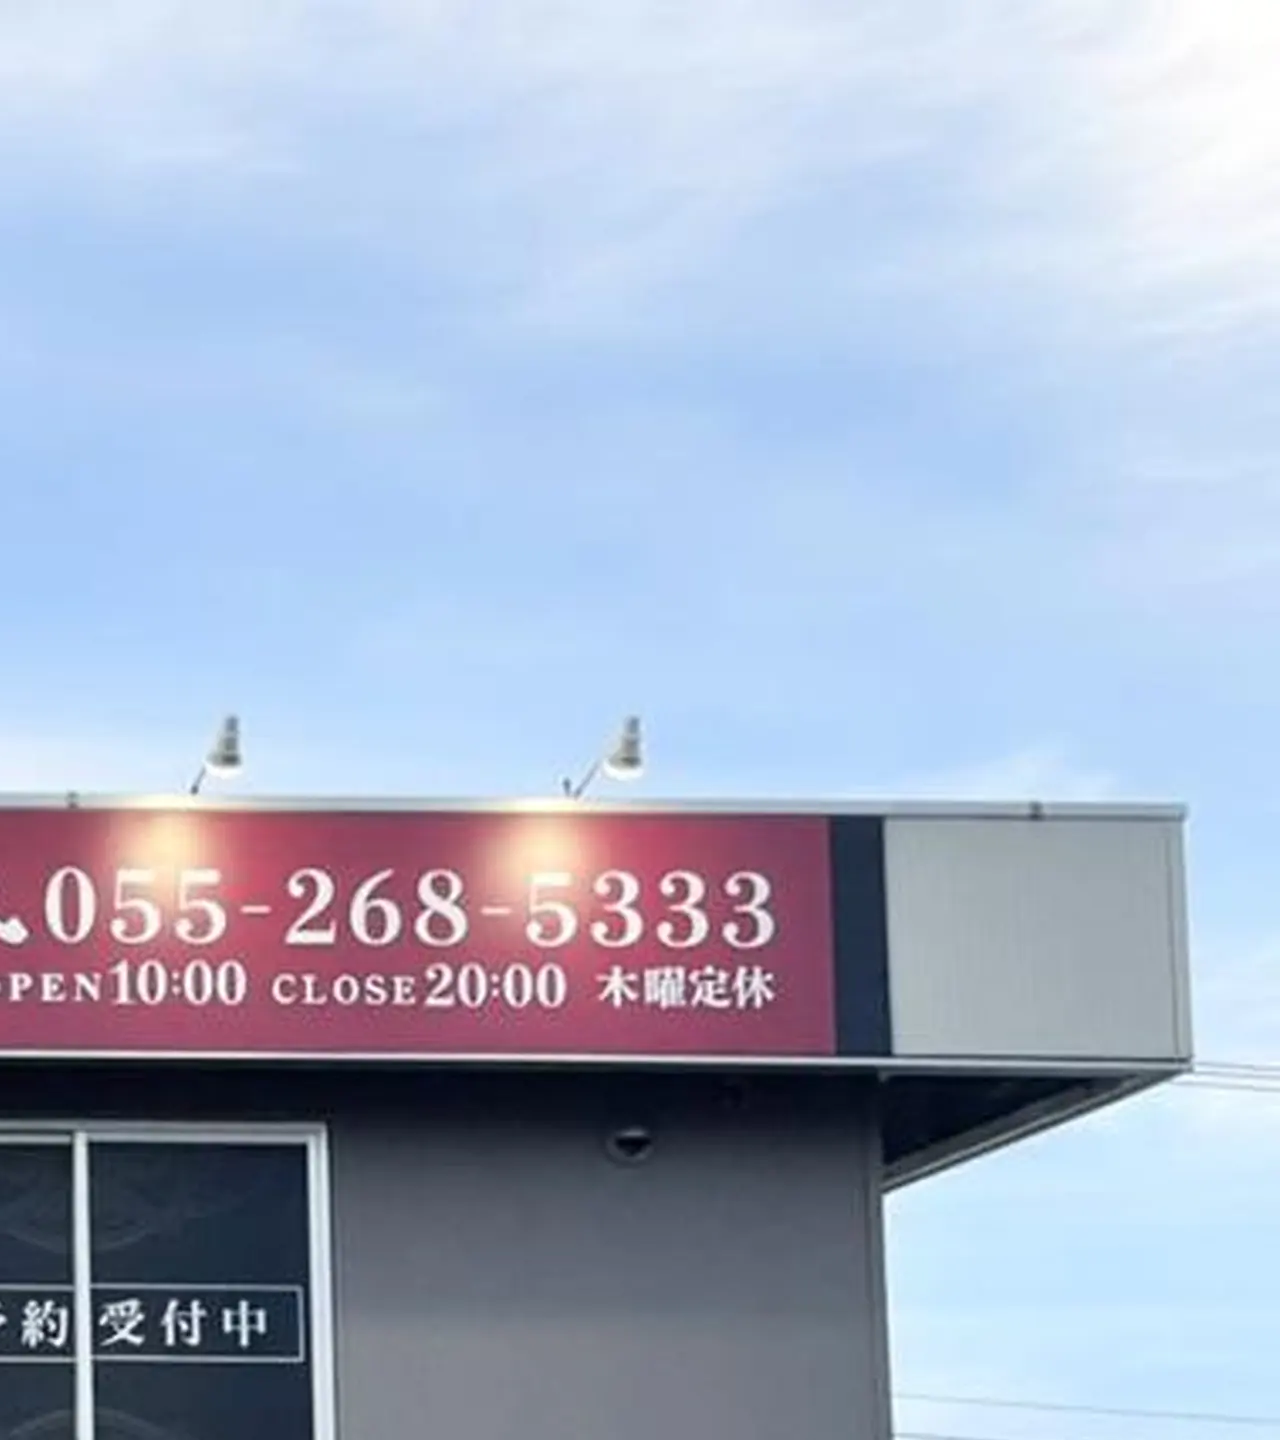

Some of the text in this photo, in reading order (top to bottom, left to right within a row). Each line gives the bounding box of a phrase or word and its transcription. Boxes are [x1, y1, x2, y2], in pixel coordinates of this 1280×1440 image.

[44, 865, 777, 948] 055-268-5333
[111, 959, 247, 1006] 10:00
[424, 962, 566, 1009] 20:00
[597, 966, 776, 1010] 木曜定休
